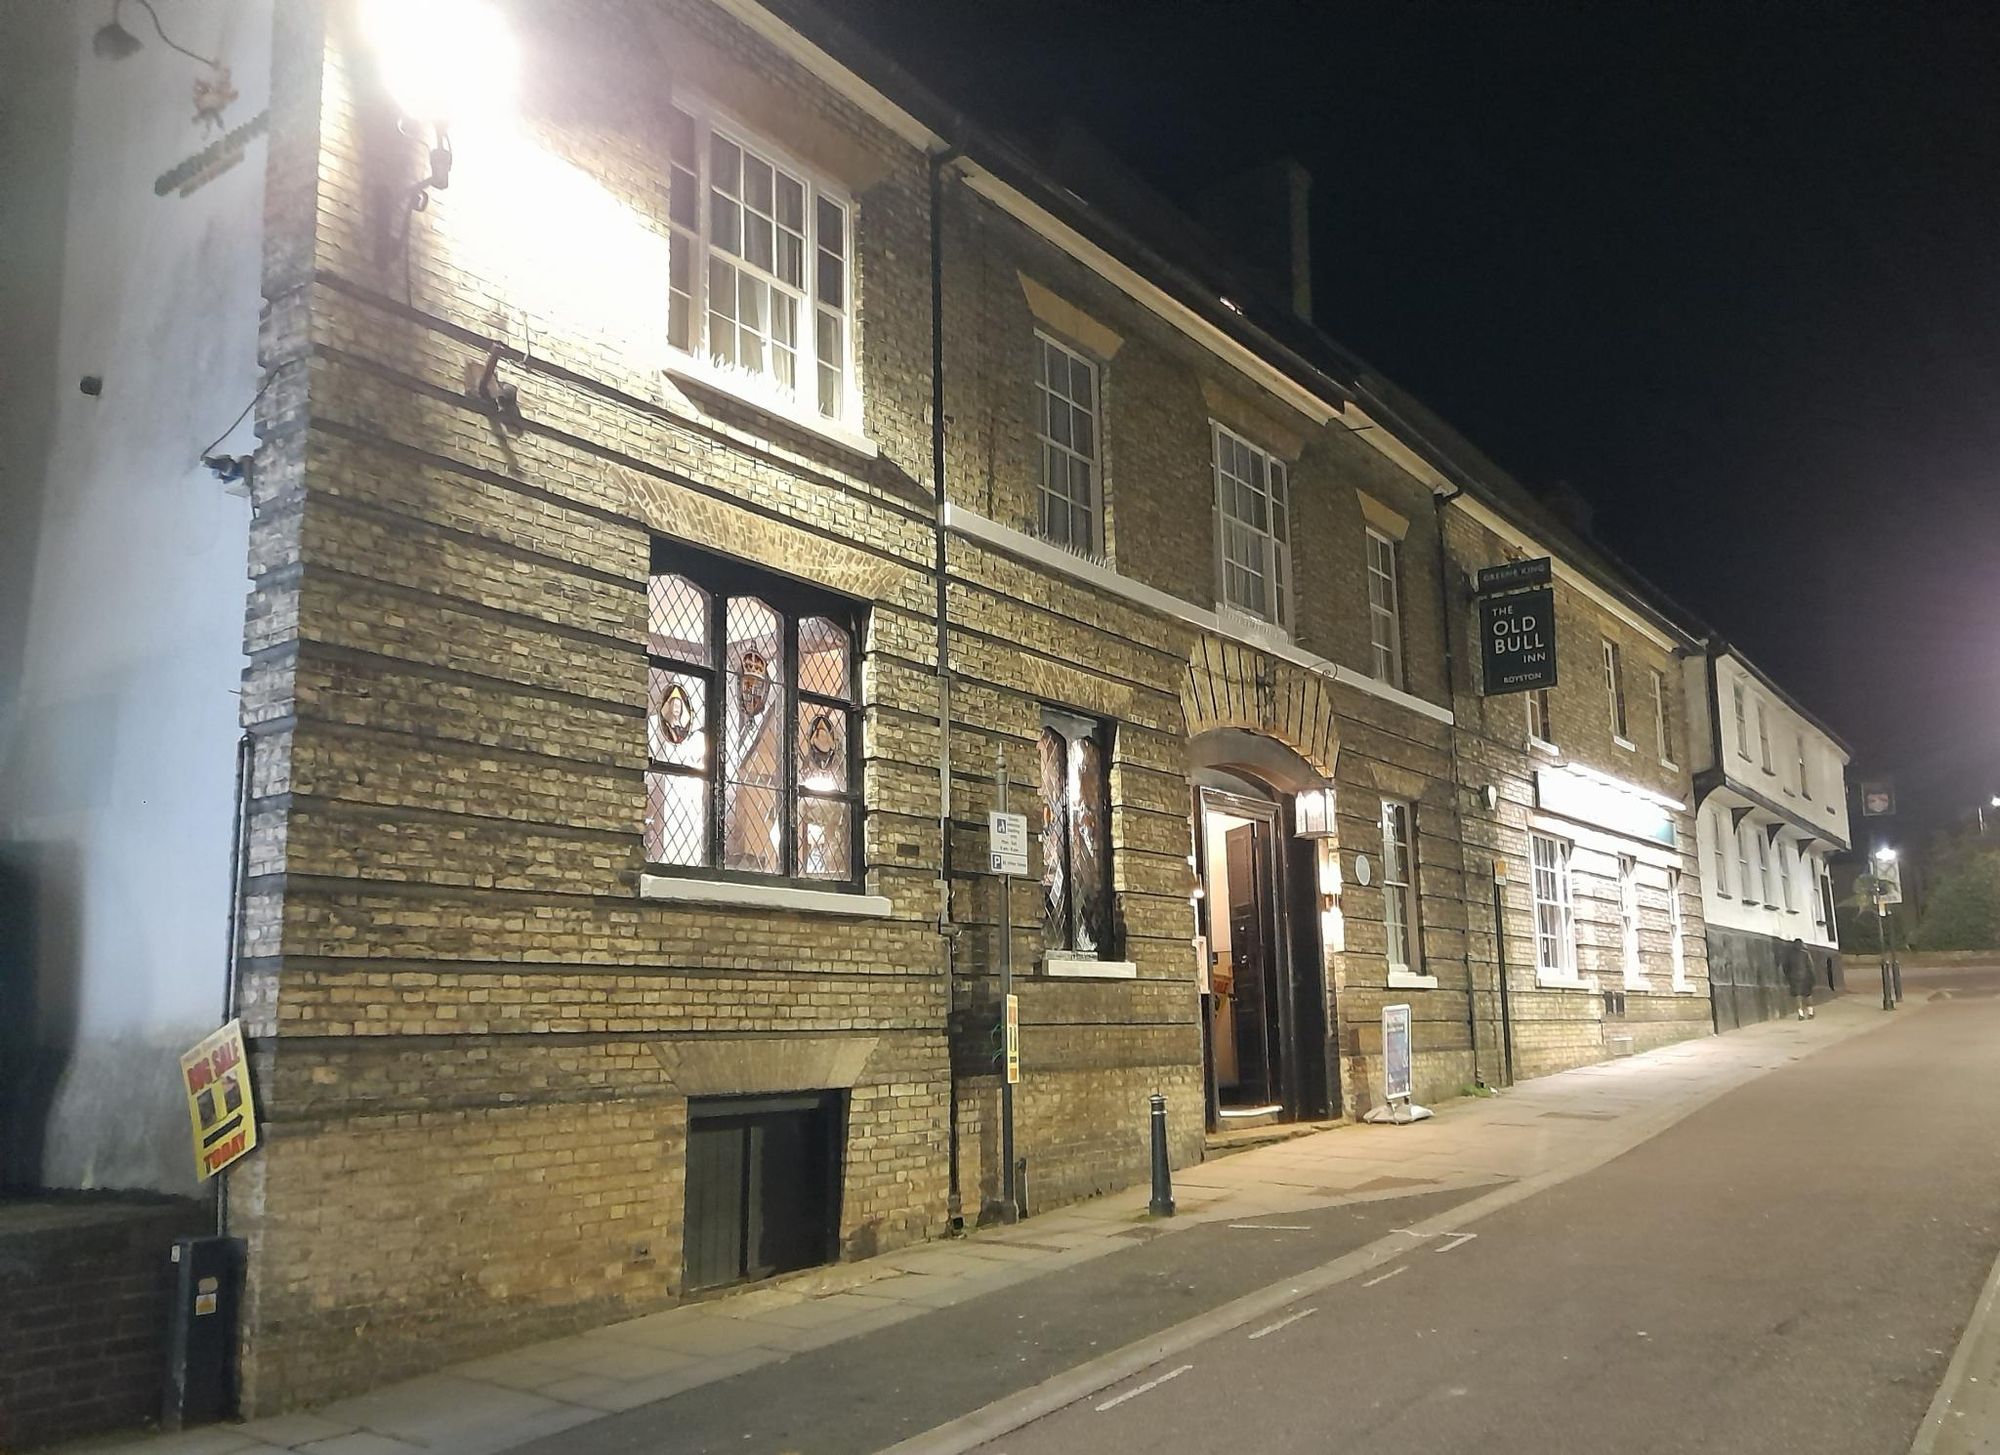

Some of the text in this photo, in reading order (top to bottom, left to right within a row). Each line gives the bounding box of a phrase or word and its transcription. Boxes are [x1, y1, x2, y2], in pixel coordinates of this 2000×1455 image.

[1492, 605, 1513, 617] THE
[1493, 616, 1536, 636] OLD
[1495, 632, 1545, 654] BULL
[1523, 651, 1546, 663] INN
[1503, 672, 1542, 684] ROYSTON
[994, 856, 1001, 868] P
[211, 1037, 240, 1078] SALE
[203, 1130, 246, 1174] TODAY
